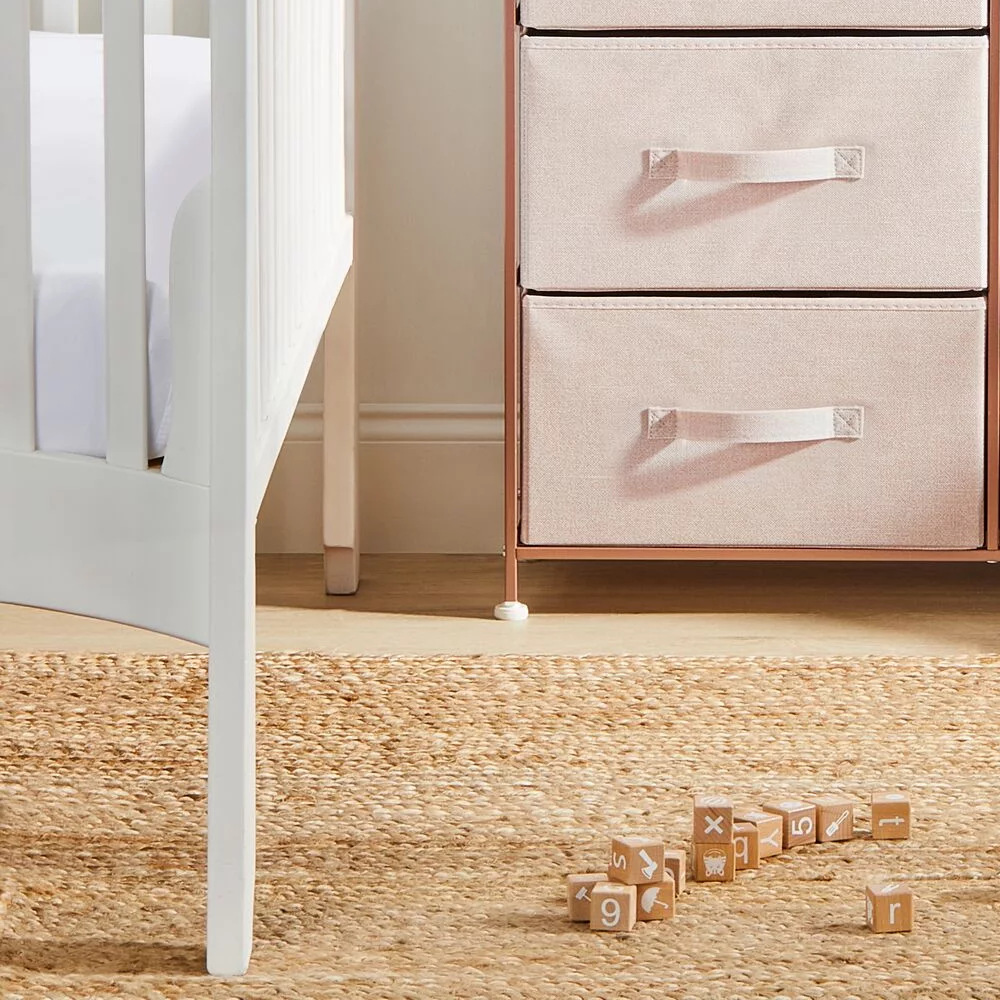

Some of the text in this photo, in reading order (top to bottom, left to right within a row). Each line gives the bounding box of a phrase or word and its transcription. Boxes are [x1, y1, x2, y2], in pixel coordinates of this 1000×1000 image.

[791, 816, 813, 836] 5
[600, 898, 621, 928] 9
[889, 902, 902, 925] r
